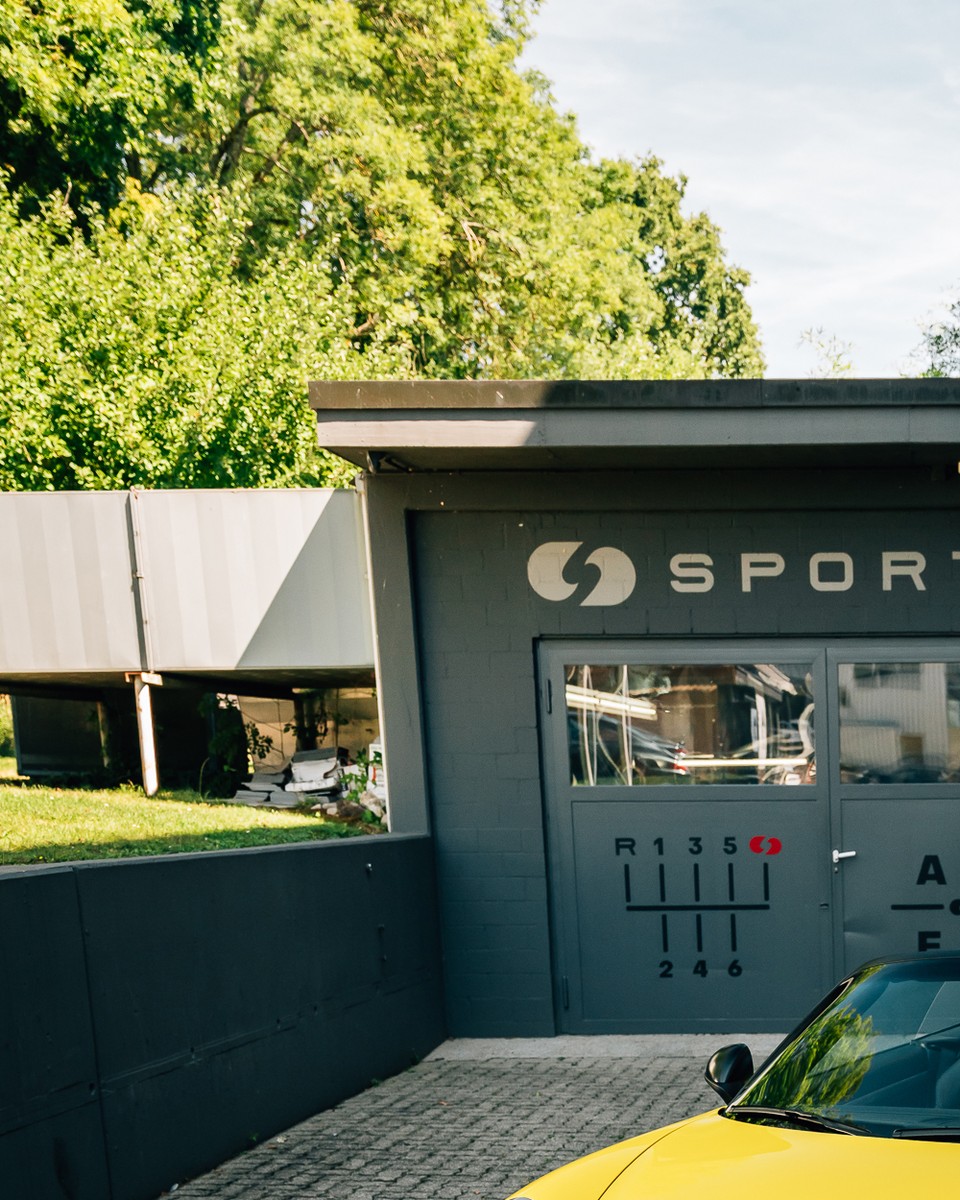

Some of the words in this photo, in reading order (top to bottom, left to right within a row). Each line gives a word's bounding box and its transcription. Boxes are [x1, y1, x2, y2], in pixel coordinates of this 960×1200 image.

[614, 837, 637, 856] R
[653, 837, 664, 856] 1
[688, 837, 703, 855] 3
[723, 836, 738, 855] 5
[916, 854, 947, 885] A
[658, 960, 674, 978] 2
[693, 960, 708, 978] 4
[728, 960, 743, 978] 6
